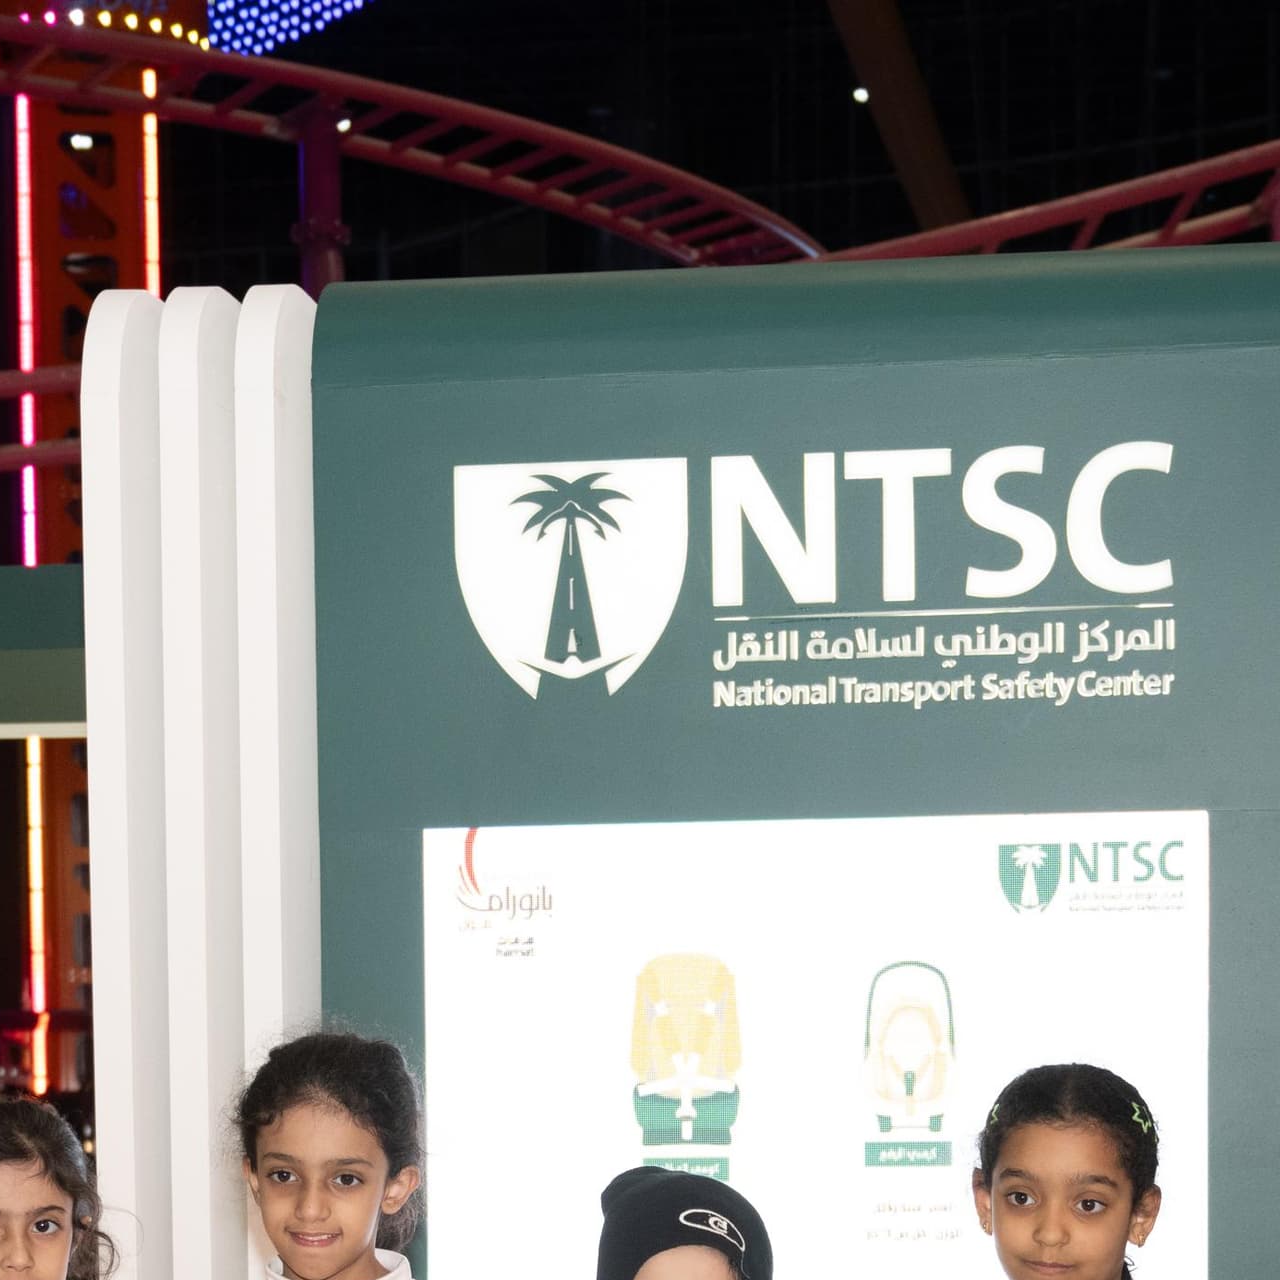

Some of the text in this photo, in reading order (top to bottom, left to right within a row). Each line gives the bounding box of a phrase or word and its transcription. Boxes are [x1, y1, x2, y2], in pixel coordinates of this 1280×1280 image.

[711, 441, 1174, 607] NTSC
[713, 619, 1176, 672] المركز الوطني لسلامة النقل
[713, 669, 1174, 711] National Transport Safety Center
[1069, 840, 1185, 883] NTSC
